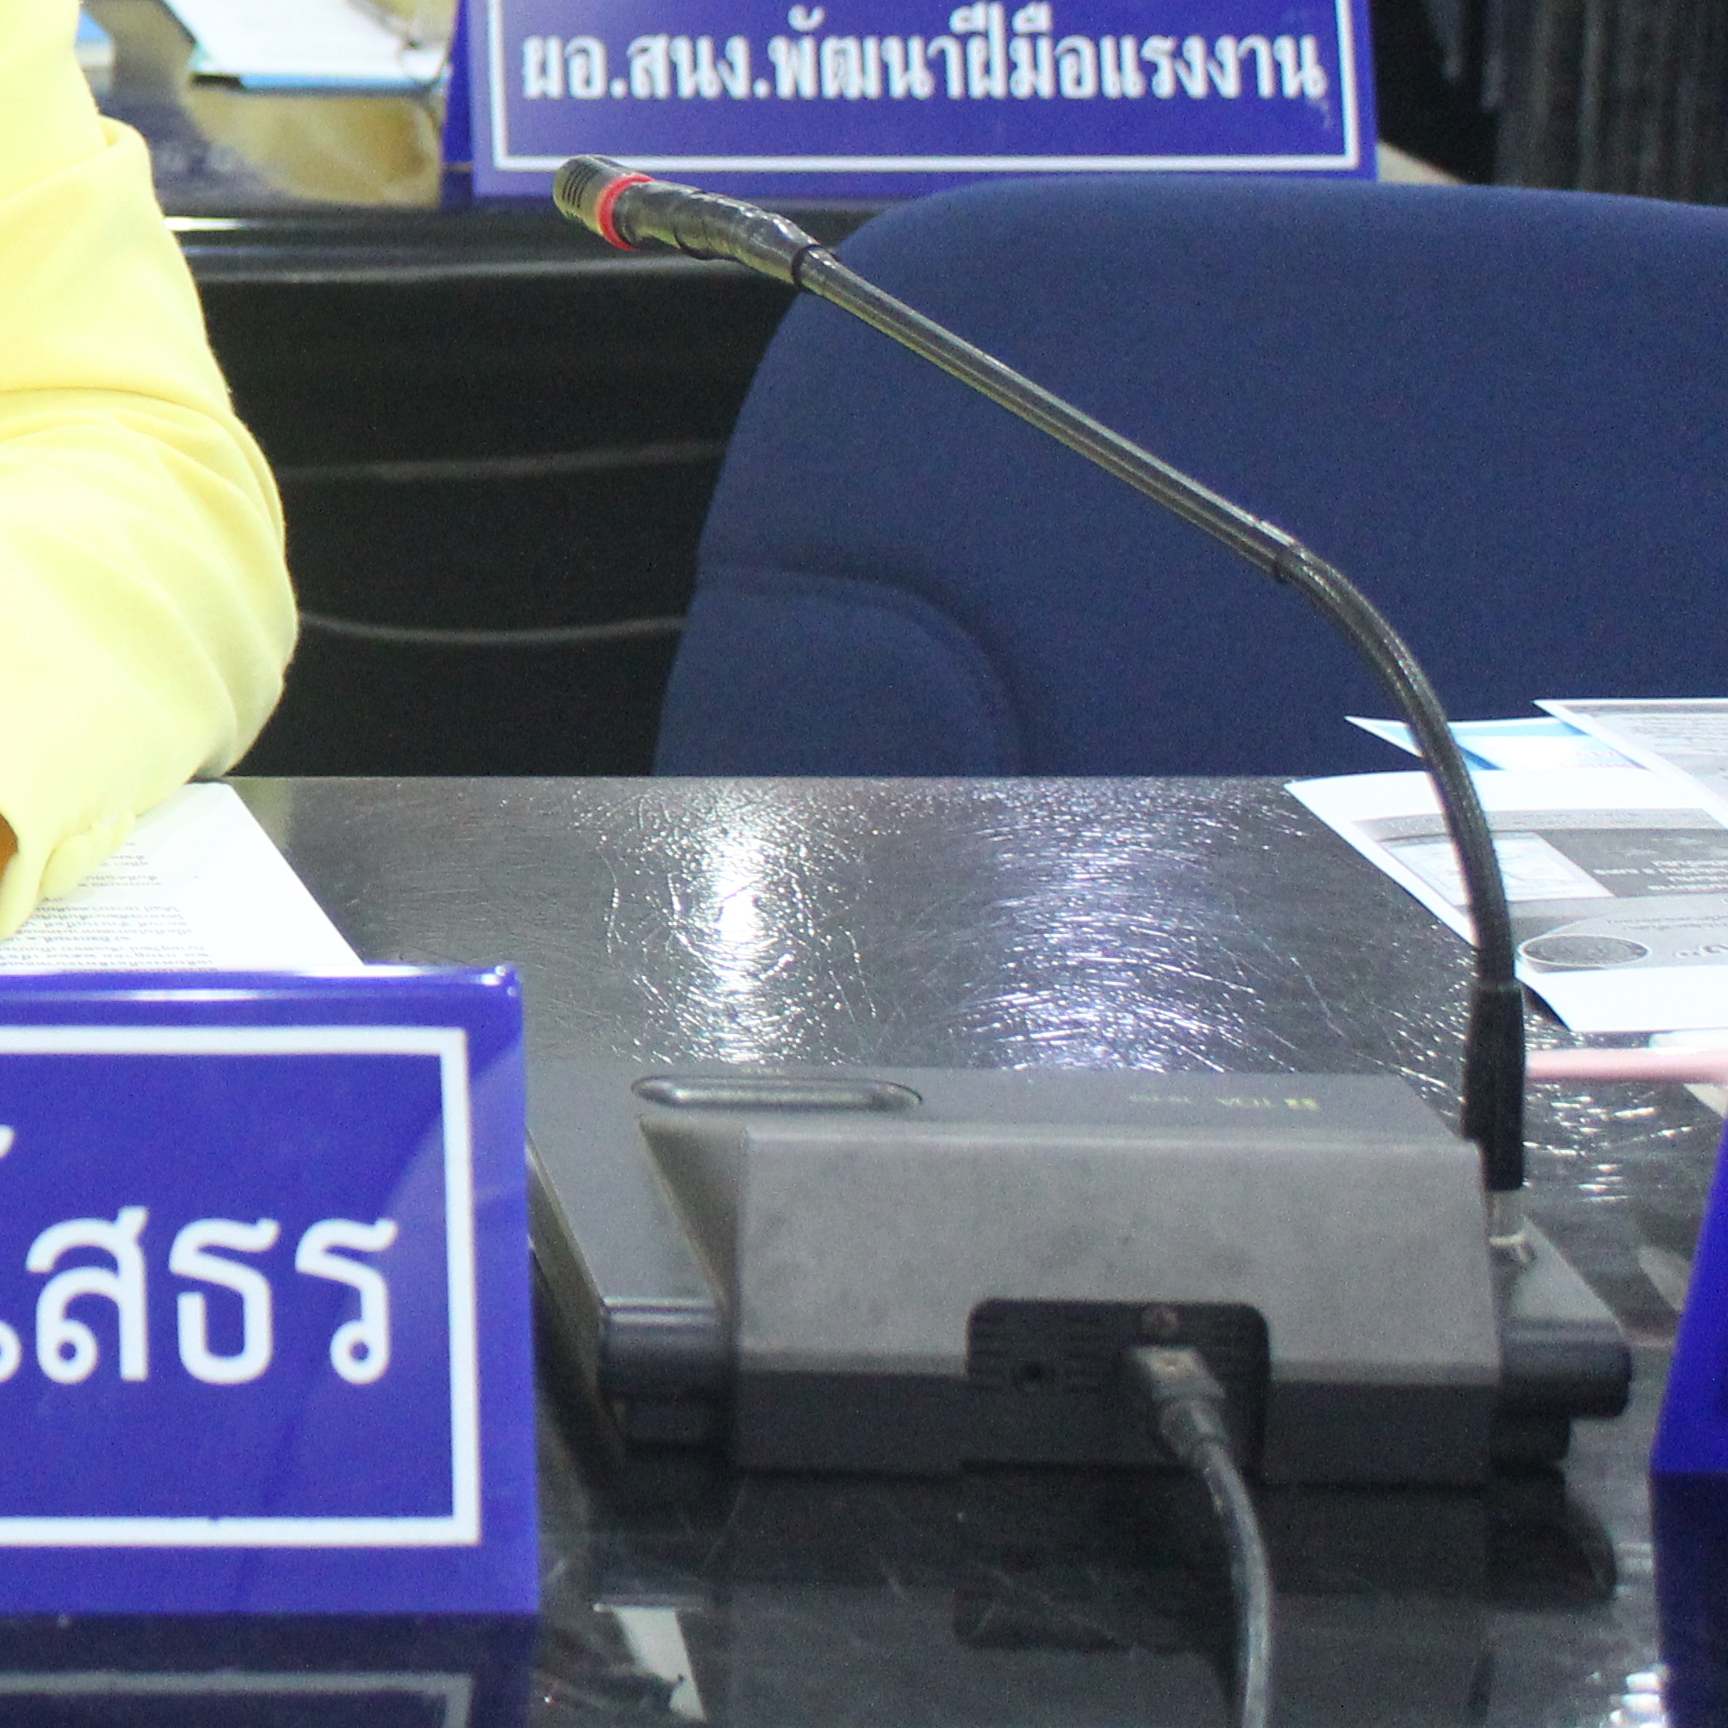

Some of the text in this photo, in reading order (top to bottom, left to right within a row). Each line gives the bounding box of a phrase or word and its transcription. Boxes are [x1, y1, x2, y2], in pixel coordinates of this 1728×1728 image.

[523, 2, 1328, 102] ผอ.สนง.พัฒนาฝีมือแรงงาน
